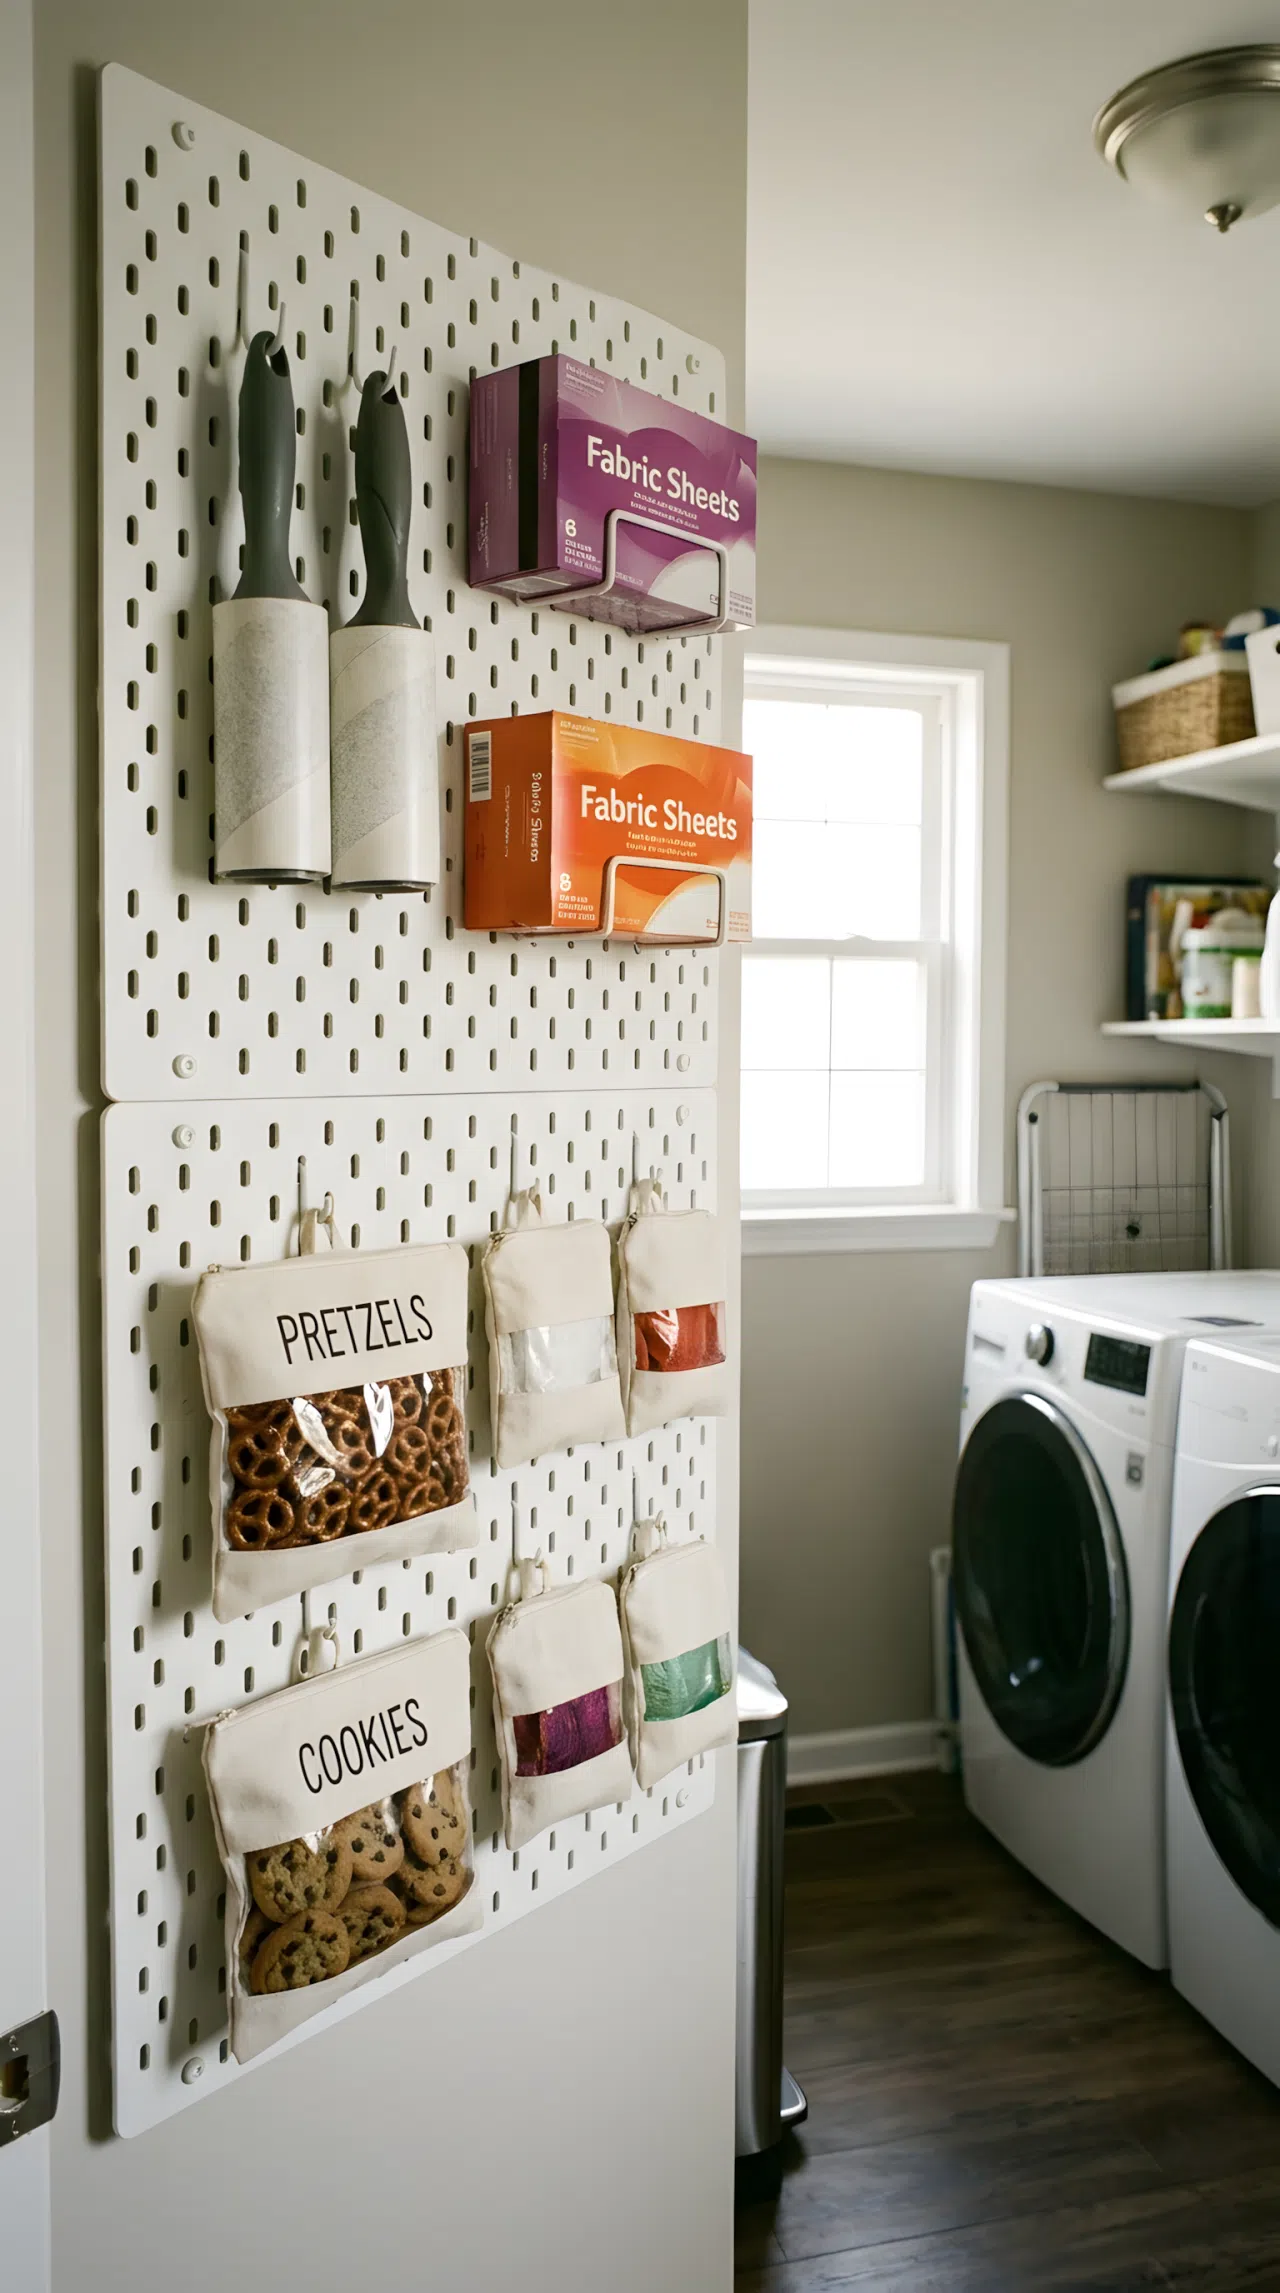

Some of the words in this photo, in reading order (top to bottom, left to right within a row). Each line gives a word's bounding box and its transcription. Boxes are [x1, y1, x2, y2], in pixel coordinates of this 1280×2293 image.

[586, 434, 662, 493] Fabric
[666, 466, 741, 523] Sheets
[564, 518, 577, 537] 6
[580, 783, 658, 828] Fabric
[663, 798, 738, 841] Sheets
[276, 1293, 434, 1366] PRETZELS
[297, 1697, 429, 1795] COOKIES
